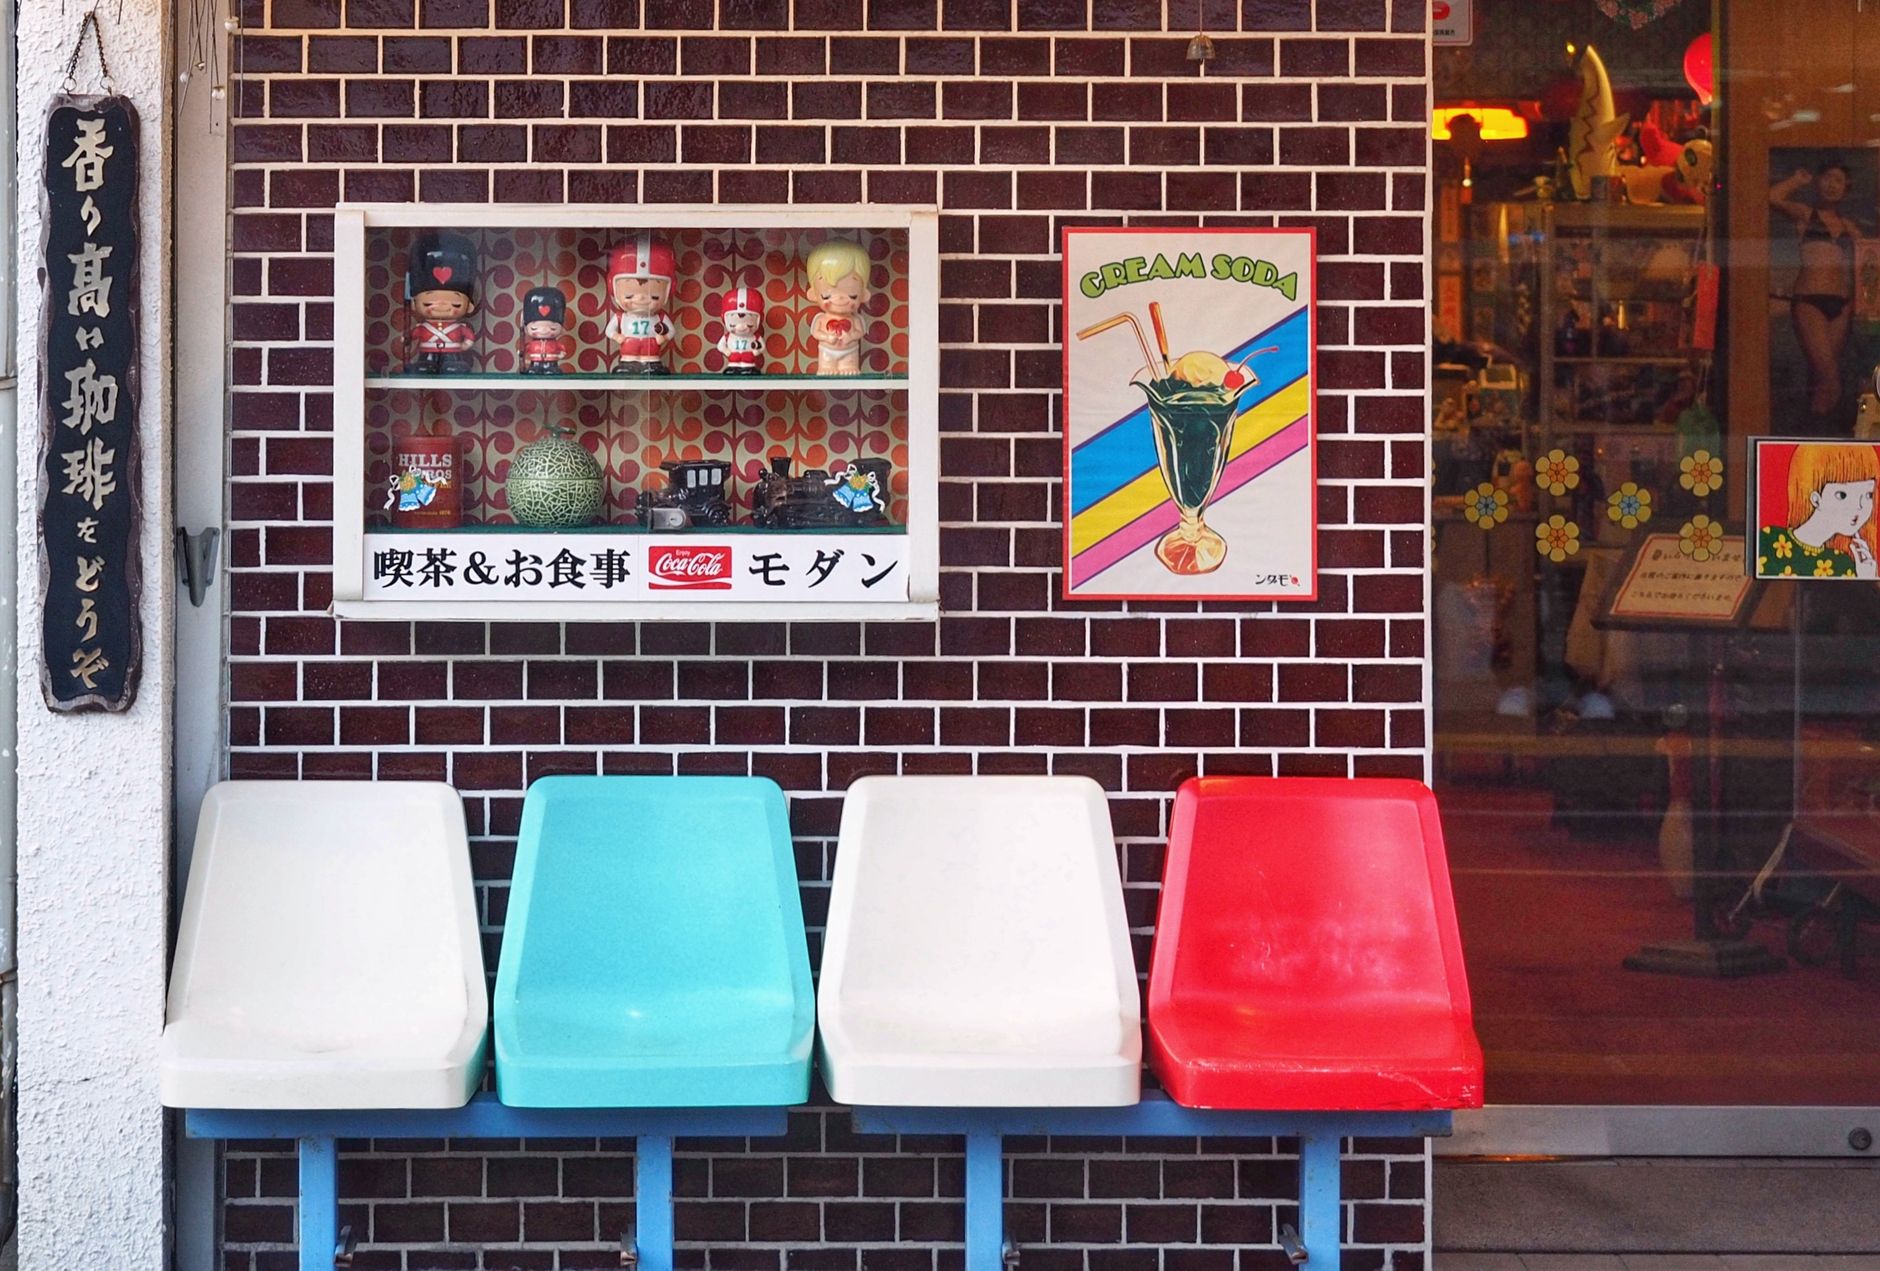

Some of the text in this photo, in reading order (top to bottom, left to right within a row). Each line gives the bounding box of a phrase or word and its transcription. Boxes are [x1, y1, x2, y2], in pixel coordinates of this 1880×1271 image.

[1080, 252, 1298, 301] CREAM SODA
[632, 321, 650, 335] 17
[735, 340, 748, 350] 17
[398, 453, 452, 467] HILLS
[373, 548, 631, 588] 喫茶&お食事
[655, 553, 725, 576] Coca-Cola
[748, 548, 899, 588] モダン
